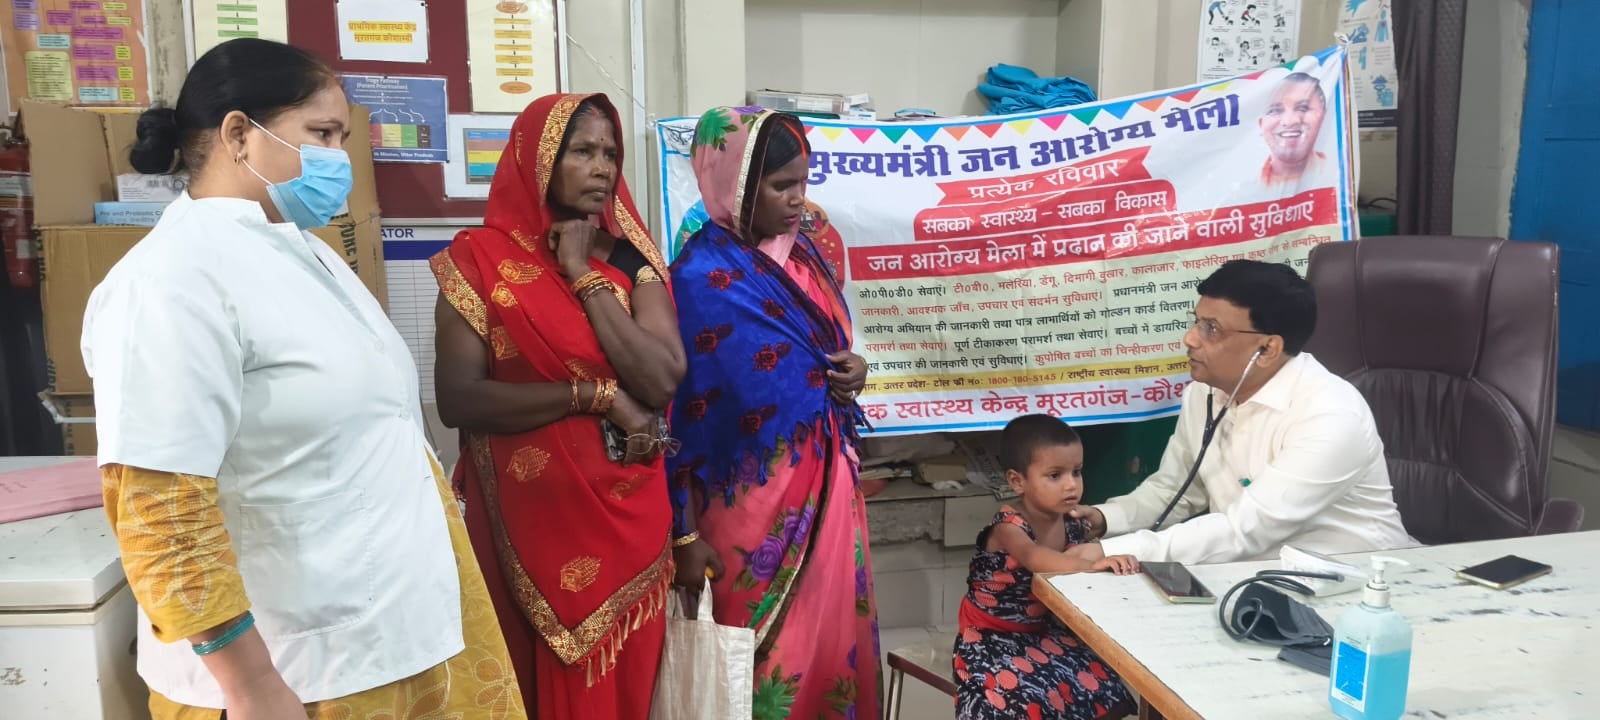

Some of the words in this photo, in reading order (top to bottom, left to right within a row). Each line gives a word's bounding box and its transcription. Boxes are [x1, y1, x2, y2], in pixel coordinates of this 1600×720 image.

[958, 145, 1021, 173] जन
[1029, 120, 1156, 167] आरोग्य
[1161, 93, 1240, 133] मेला
[968, 177, 1034, 200] प्रत्येक
[1043, 157, 1122, 187] रविवार
[922, 216, 972, 234] सबका
[980, 206, 1038, 229] स्वास्थ्य
[1057, 199, 1106, 218] सबका
[1115, 190, 1168, 211] विकास
[867, 255, 903, 271] जन
[909, 244, 980, 271] आरोग्य
[986, 239, 1027, 263] मेला
[1031, 233, 1047, 258] में
[1052, 233, 1106, 257] प्रदान
[1111, 223, 1138, 248] की
[1144, 216, 1189, 245] जाने
[1196, 213, 1243, 239] वाली
[1249, 193, 1315, 238] सुविधाएं
[1064, 269, 1095, 284] दिमागी
[1182, 253, 1229, 270] फाइलेरिया
[907, 305, 946, 316] आवश्यक
[976, 300, 1008, 312] उपचार
[1112, 281, 1156, 297] प्रधानमंत्री
[1160, 283, 1177, 292] जन
[864, 321, 893, 334] आरोग्य
[897, 322, 932, 334] अभियान
[935, 320, 947, 332] की
[951, 318, 990, 330] जानकारी
[993, 319, 1012, 329] तथा
[1015, 317, 1033, 328] पात्र
[1036, 310, 1081, 325] लाभार्थियों
[1083, 308, 1096, 320] को
[1100, 307, 1130, 319] गोल्डन
[1134, 301, 1155, 314] कार्ड
[899, 342, 916, 351] तथा
[954, 338, 969, 352] पूर्ण
[973, 337, 1018, 350] टीकाकरण
[1021, 331, 1053, 345] परामर्श
[1056, 332, 1074, 342] तथा
[1114, 323, 1138, 336] बच्चों
[1140, 322, 1149, 334] में
[883, 360, 912, 371] उपचार
[915, 358, 927, 369] की
[930, 356, 969, 369] जानकारी
[972, 355, 985, 367] एवं
[1035, 350, 1070, 366] कुपोषित
[1074, 347, 1097, 359] बच्चों
[1100, 347, 1112, 357] का
[1116, 342, 1164, 355] चिन्हीकरण
[1067, 366, 1095, 381] राष्ट्रीय
[894, 398, 974, 419] स्वास्थ्य
[981, 391, 1028, 413] केन्द्र
